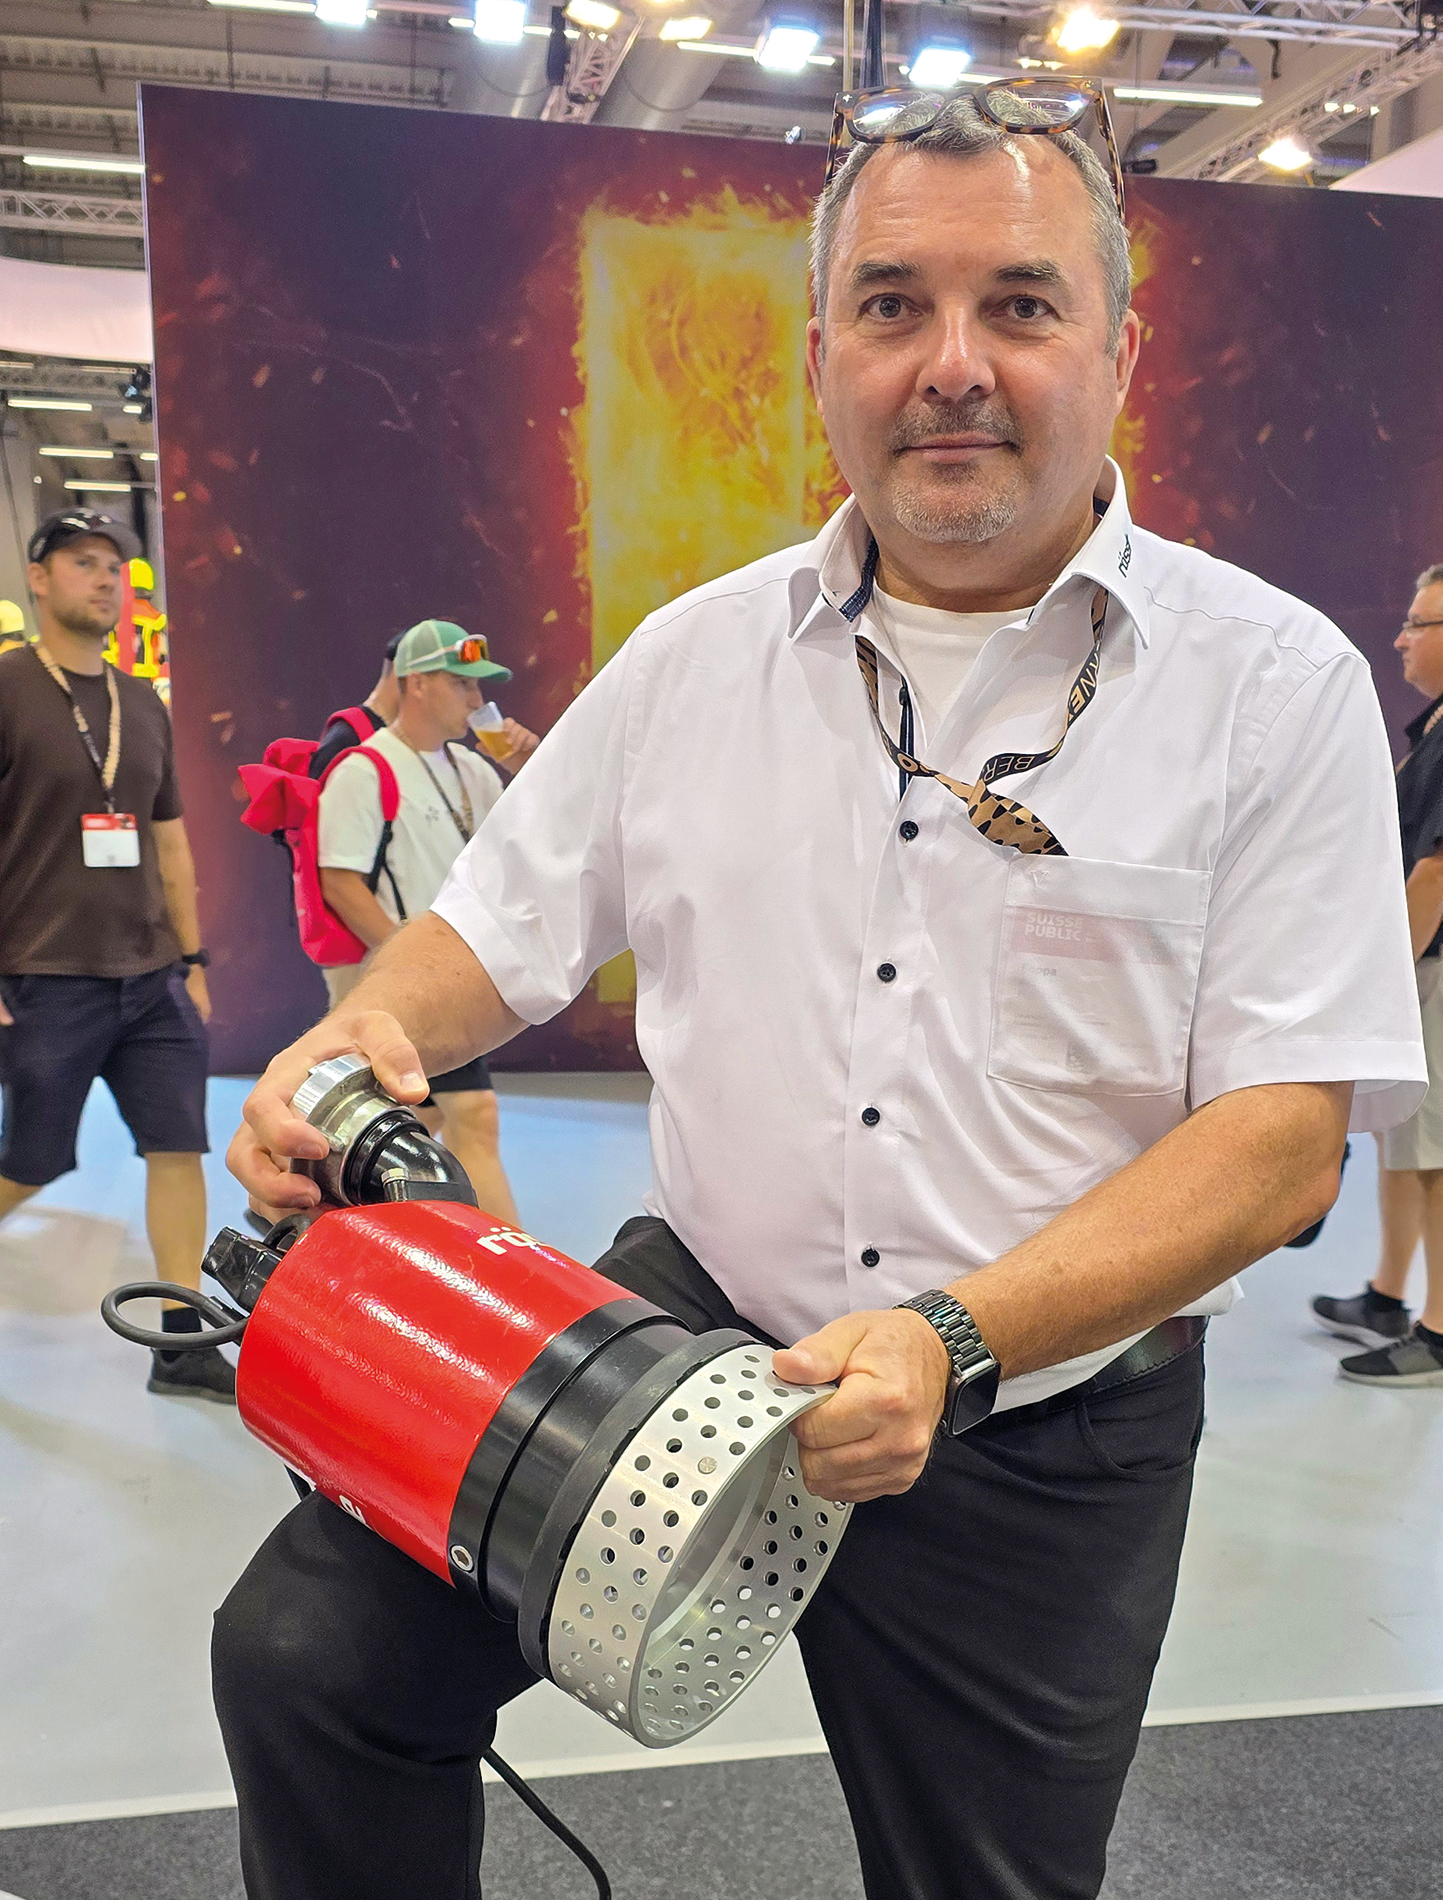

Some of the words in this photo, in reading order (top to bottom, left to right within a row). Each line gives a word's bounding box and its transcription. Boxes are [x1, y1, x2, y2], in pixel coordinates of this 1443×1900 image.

[983, 755, 1035, 782] BER
[1026, 912, 1084, 929] SUISSE
[1024, 924, 1081, 941] PUBLIC
